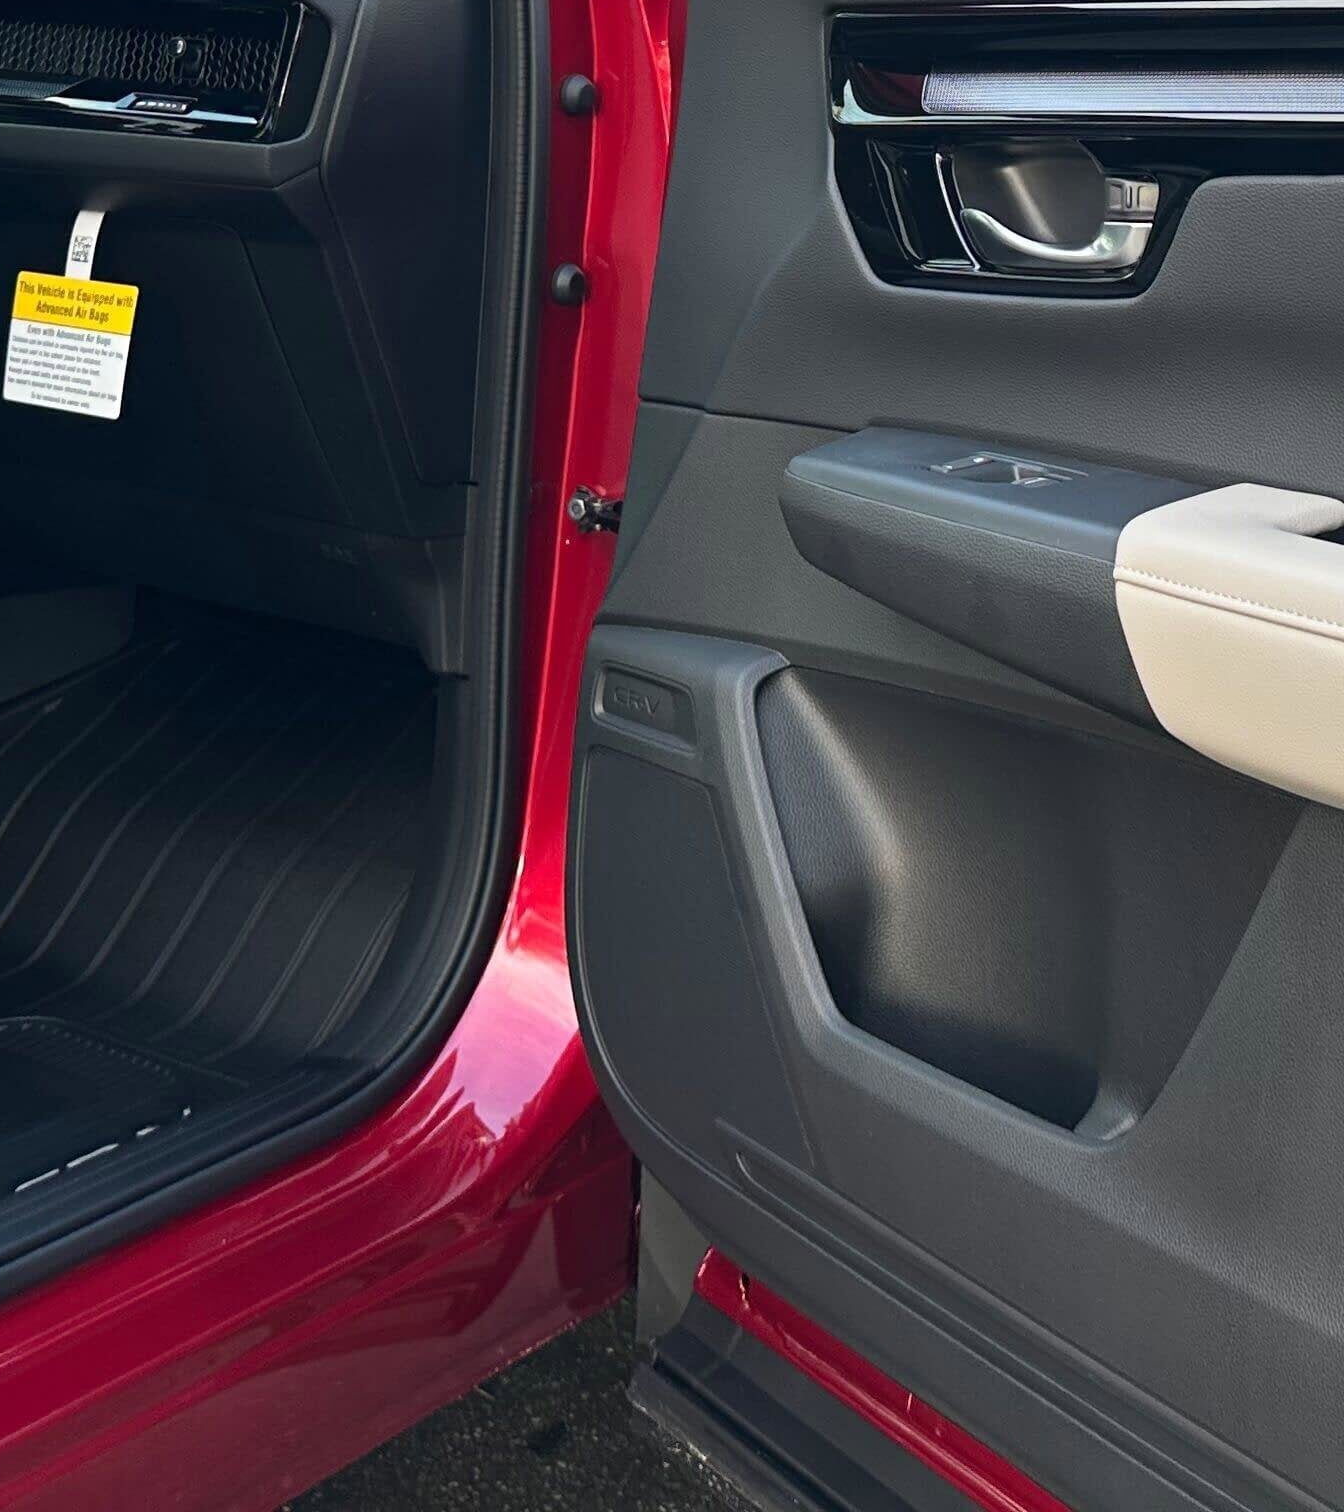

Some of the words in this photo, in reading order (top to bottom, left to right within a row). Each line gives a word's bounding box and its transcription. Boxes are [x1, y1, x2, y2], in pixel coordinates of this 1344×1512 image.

[19, 280, 35, 294] This
[37, 284, 66, 299] Vehicle
[67, 289, 75, 300] is
[76, 289, 115, 307] Equipped
[116, 295, 134, 308] with
[36, 300, 74, 317] Advanced
[75, 306, 88, 318] Air
[89, 308, 110, 324] Bags
[612, 686, 661, 715] CR-V
